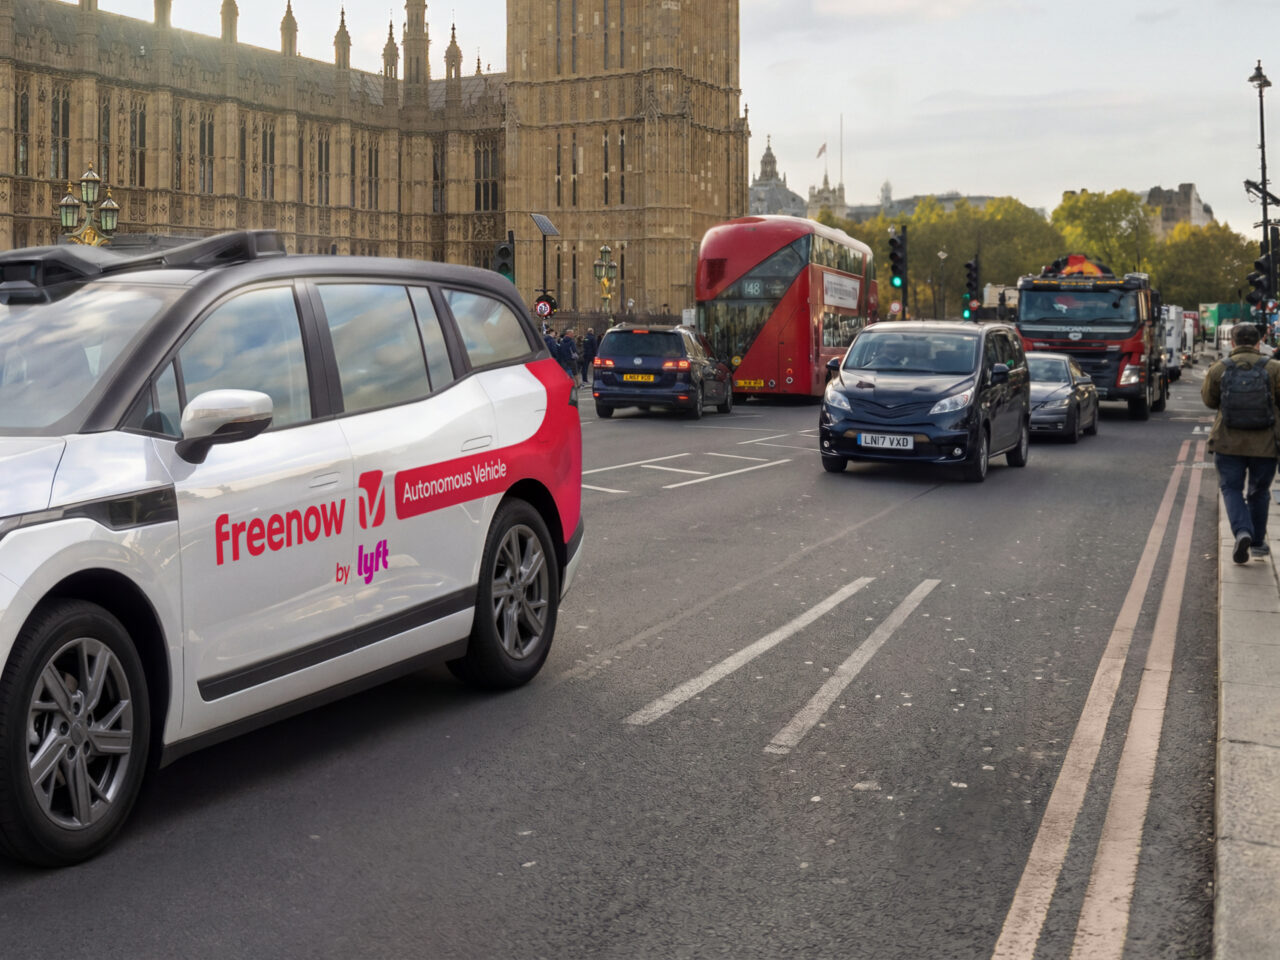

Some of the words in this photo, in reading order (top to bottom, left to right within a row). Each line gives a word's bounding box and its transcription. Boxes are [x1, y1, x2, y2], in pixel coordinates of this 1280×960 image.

[744, 282, 760, 295] 148
[864, 435, 886, 446] LN17
[889, 437, 909, 447] VXD
[403, 475, 472, 504] Autonomous
[472, 458, 507, 484] Vehicle
[336, 562, 350, 585] by
[357, 539, 389, 585] lyft
